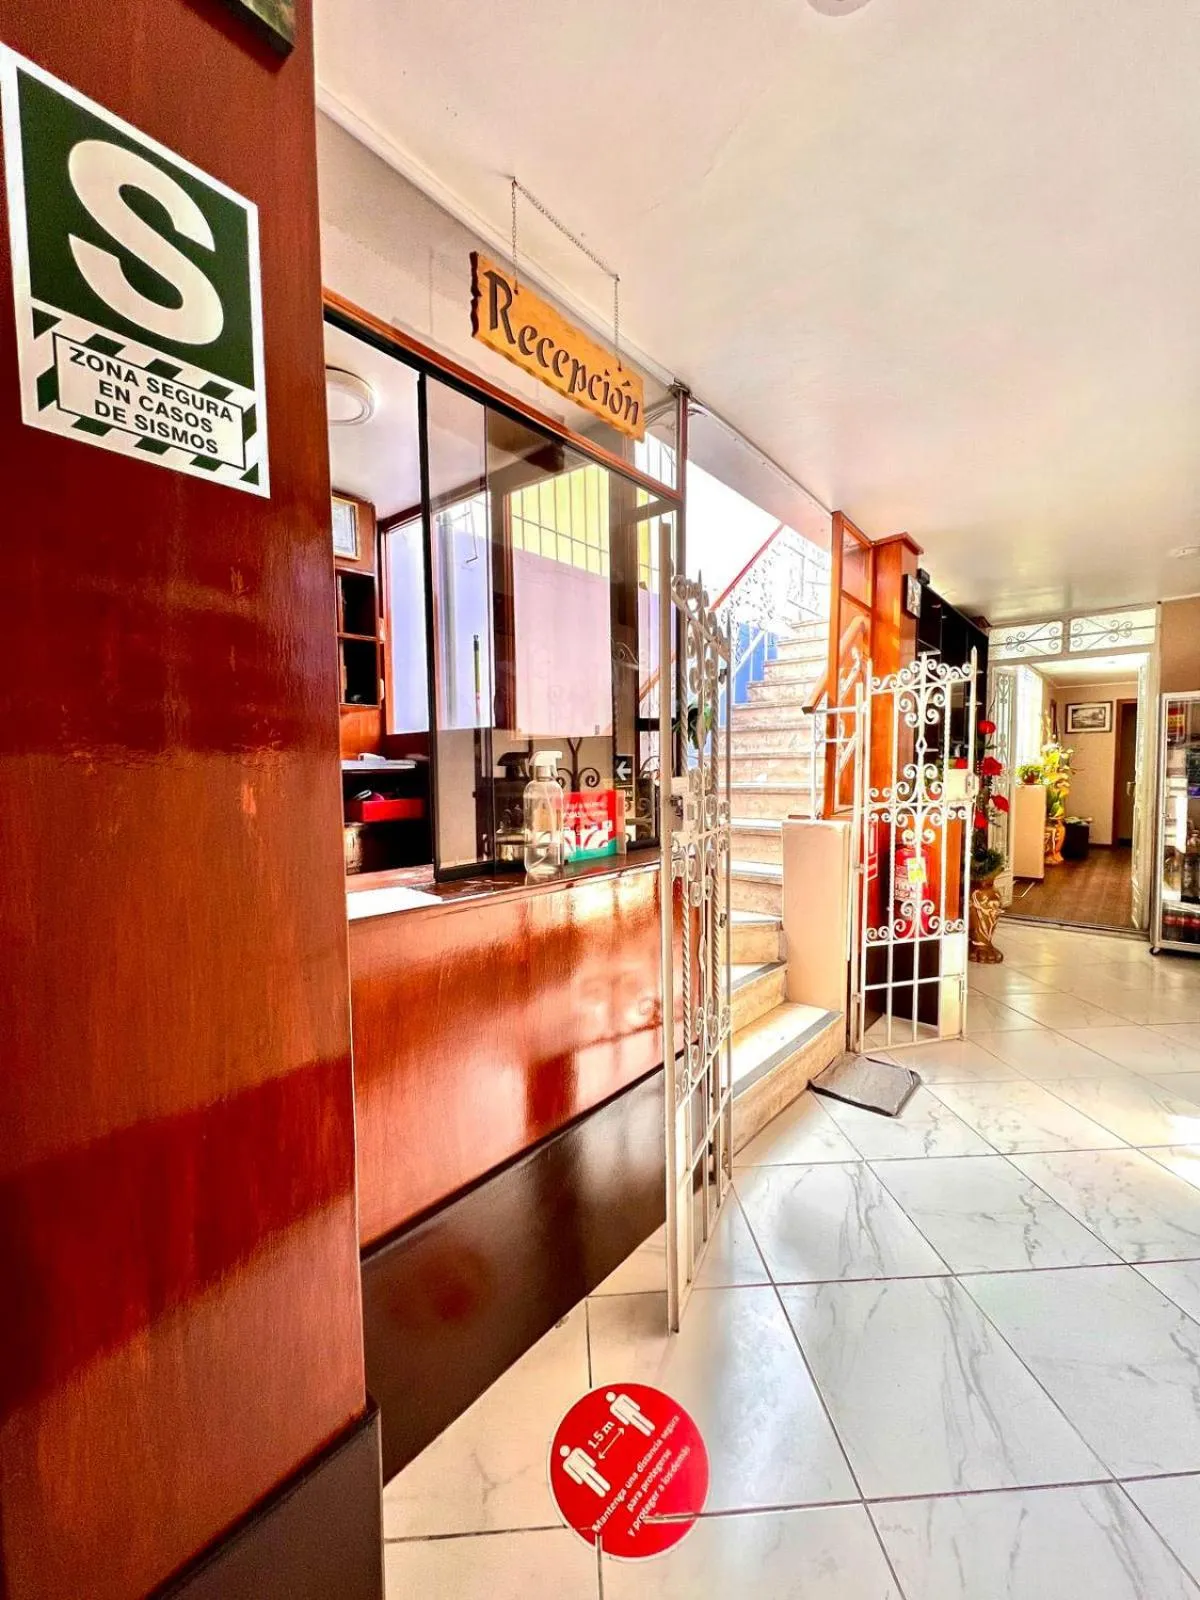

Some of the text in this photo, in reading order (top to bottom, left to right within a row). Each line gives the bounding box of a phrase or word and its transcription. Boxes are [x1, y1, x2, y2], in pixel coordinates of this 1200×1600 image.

[68, 139, 224, 345] S
[483, 270, 638, 426] Recepción
[69, 346, 233, 422] ZONA SEGURA
[99, 379, 213, 433] EN CASOS
[94, 399, 219, 454] DE SISMOS
[602, 1420, 615, 1436] m
[591, 1414, 681, 1533] Mantenga una distancia segura
[625, 1448, 673, 1513] para protegerse
[632, 1491, 661, 1532] proteger
[659, 1481, 666, 1492] a
